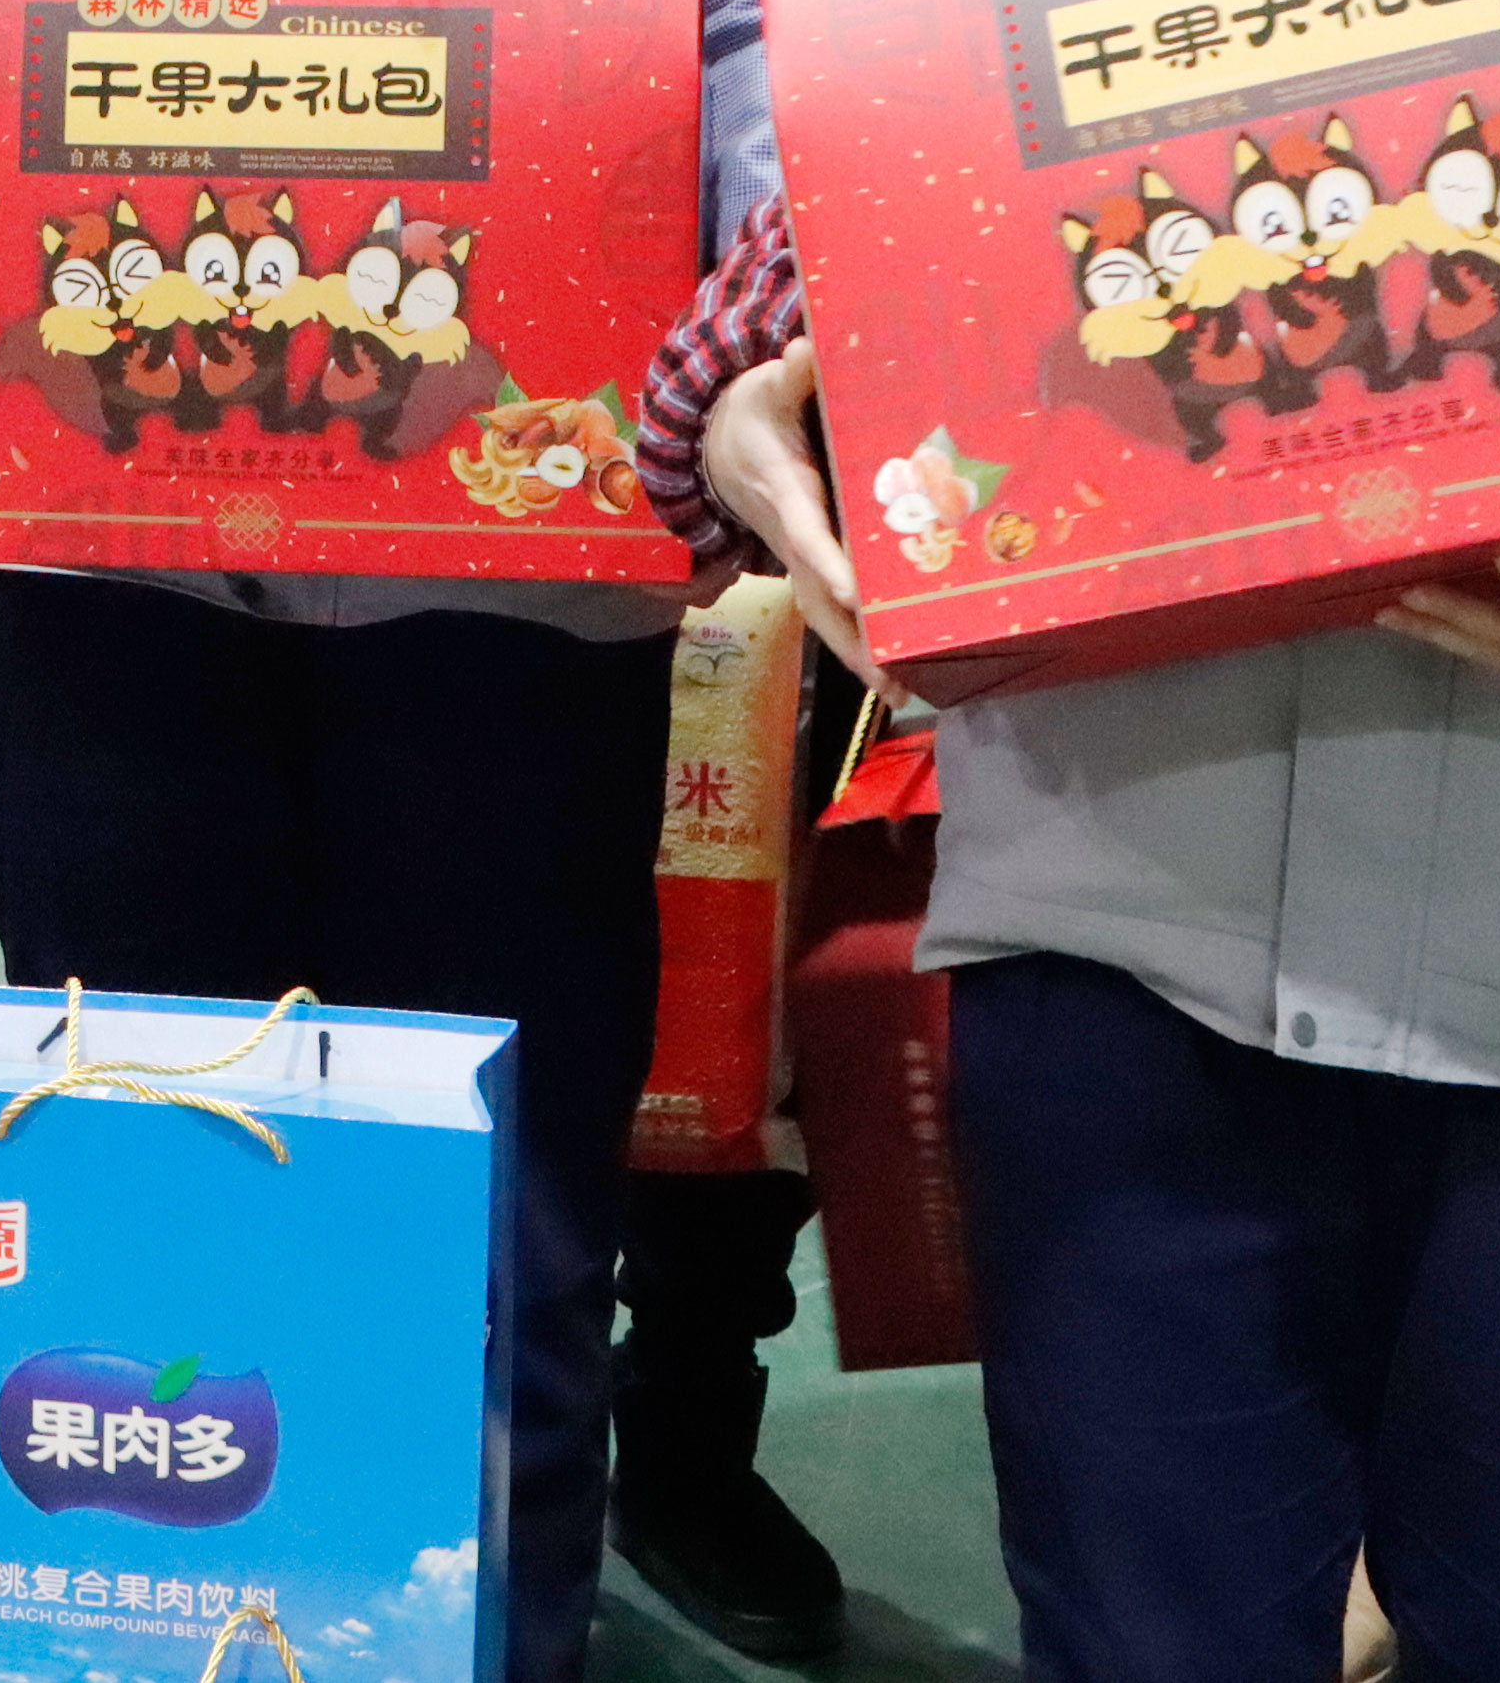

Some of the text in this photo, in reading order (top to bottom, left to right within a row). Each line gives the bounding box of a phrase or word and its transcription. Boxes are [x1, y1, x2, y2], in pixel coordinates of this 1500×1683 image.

[279, 14, 426, 37] Chinese
[69, 60, 443, 119] 干果大礼包
[69, 147, 133, 169] 自然态
[147, 149, 216, 171] 好滋味
[26, 1399, 248, 1484] 果肉多
[56, 1611, 170, 1638] COMPOUND
